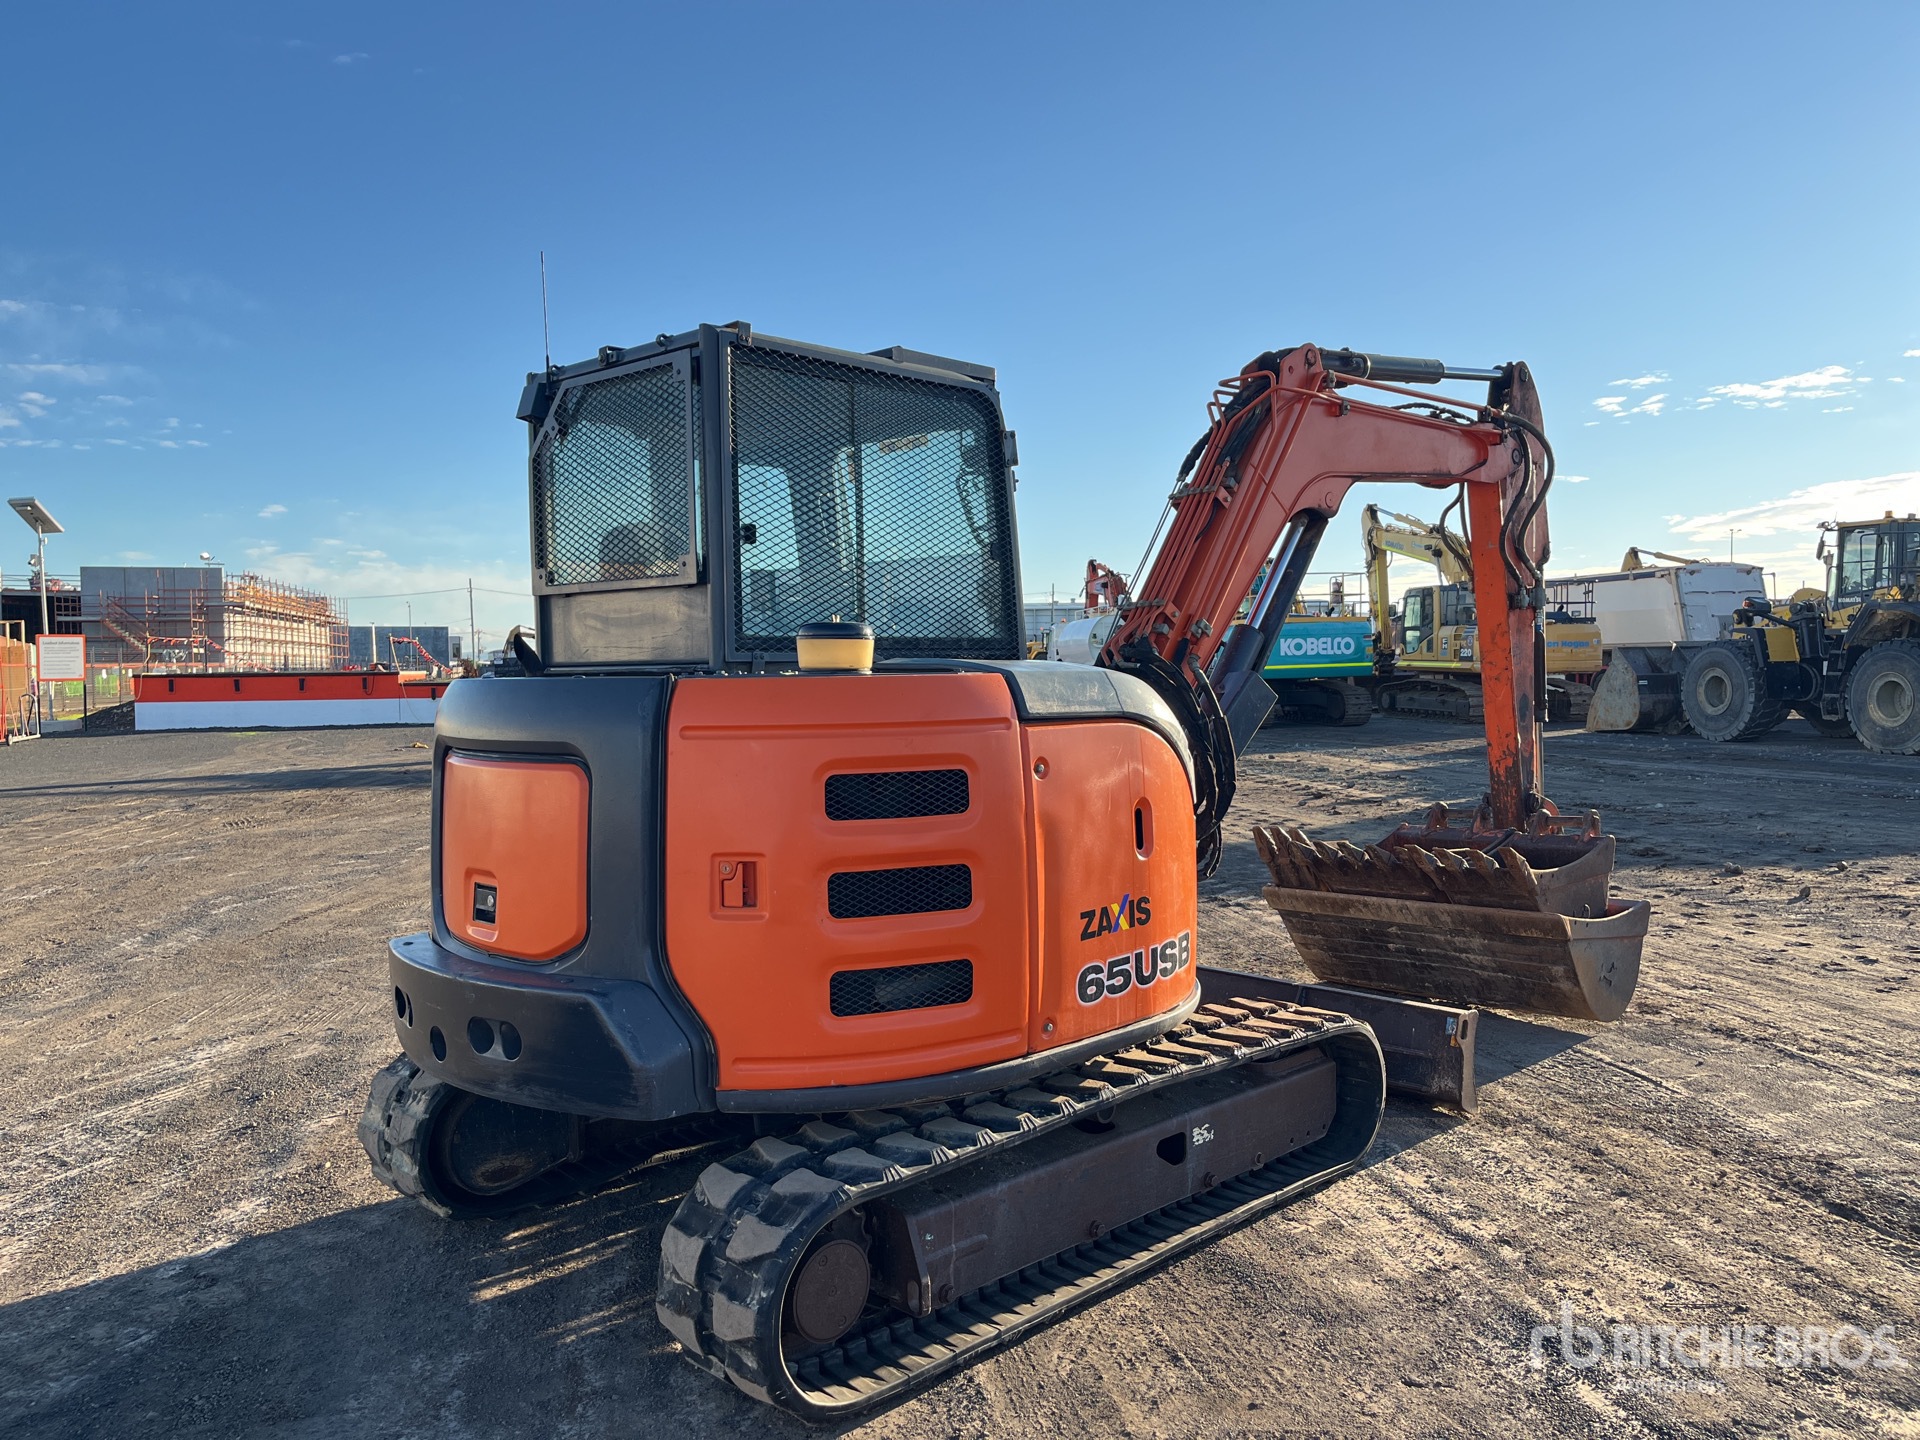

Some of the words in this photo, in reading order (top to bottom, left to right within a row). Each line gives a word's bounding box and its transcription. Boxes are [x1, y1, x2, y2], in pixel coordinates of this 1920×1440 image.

[1280, 637, 1355, 656] KOBELCO
[1460, 648, 1472, 657] 220
[1080, 893, 1151, 941] ZAXIS
[1077, 930, 1191, 1006] 65USB
